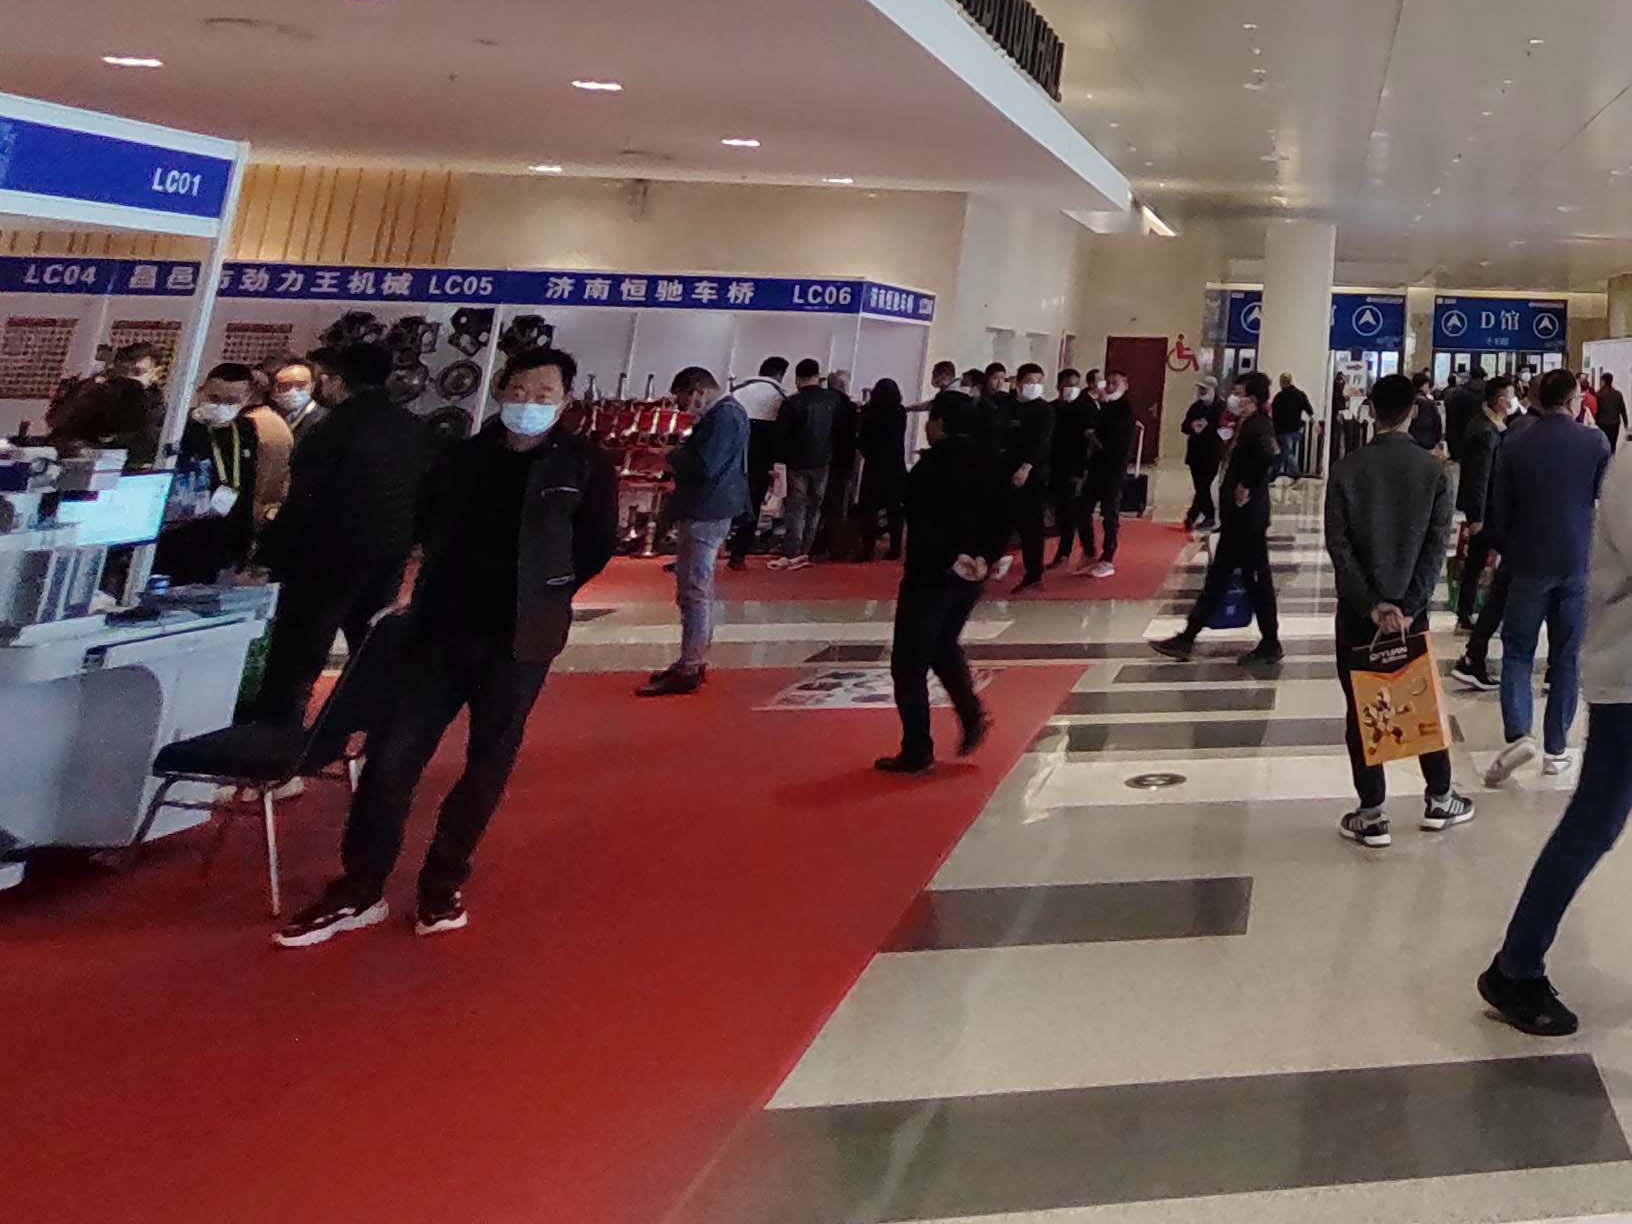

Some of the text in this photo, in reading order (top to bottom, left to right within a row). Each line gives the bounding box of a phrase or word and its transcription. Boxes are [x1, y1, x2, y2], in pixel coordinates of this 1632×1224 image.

[151, 167, 203, 197] LC01
[23, 263, 98, 286] LC04
[429, 276, 495, 297] LC05
[544, 275, 853, 305] 济南恒驰车桥 LC06
[1479, 309, 1521, 331] D 馆
